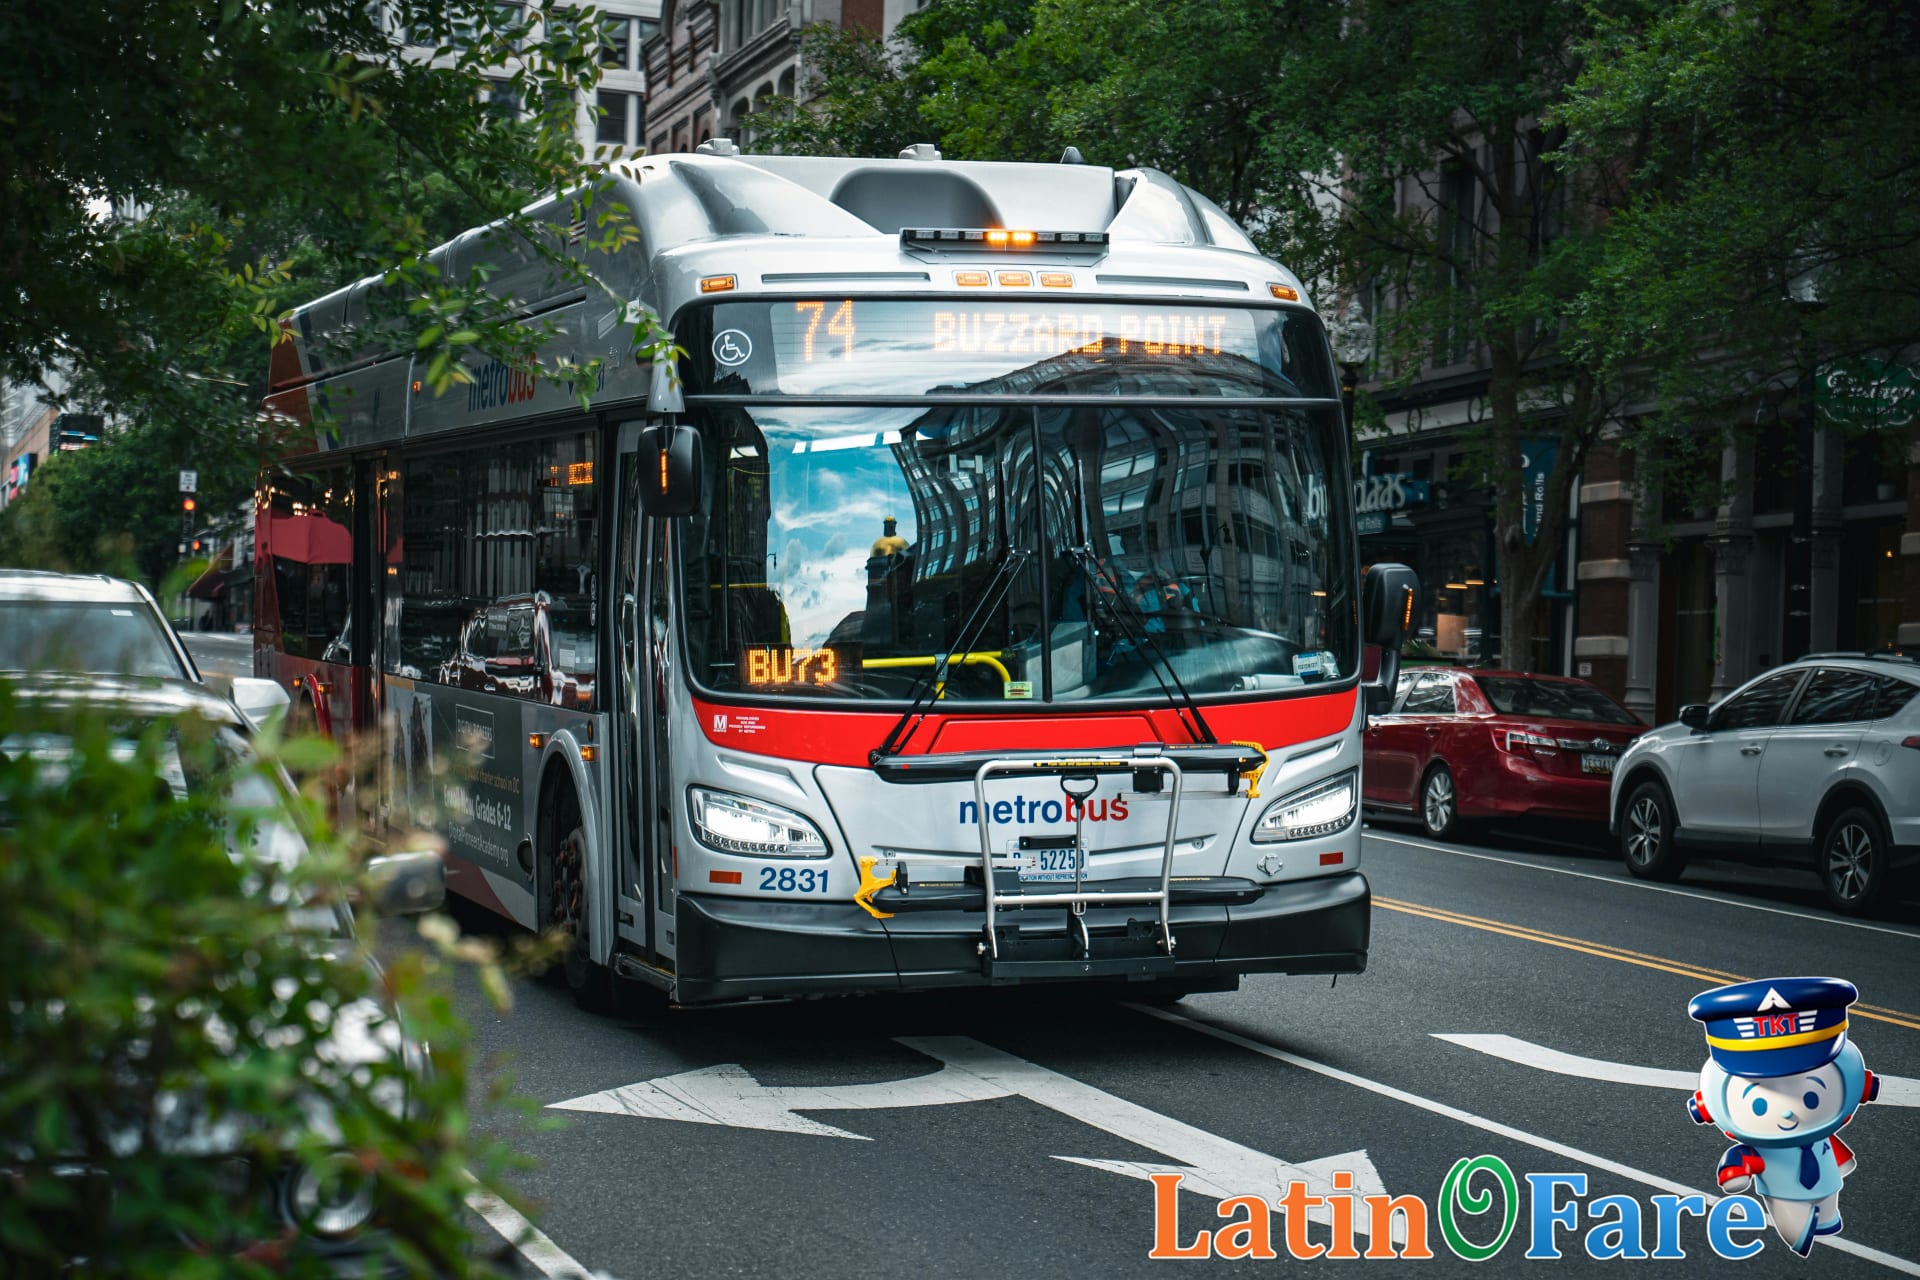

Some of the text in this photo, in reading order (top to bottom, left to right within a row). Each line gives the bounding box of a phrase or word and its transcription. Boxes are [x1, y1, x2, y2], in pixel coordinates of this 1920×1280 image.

[795, 300, 1226, 361] 74 BUZZARD POINT
[749, 648, 835, 684] BU73
[475, 794, 496, 826] Grades
[496, 801, 512, 832] 6-12
[959, 794, 1129, 824] metrobus
[759, 867, 829, 893] 2831
